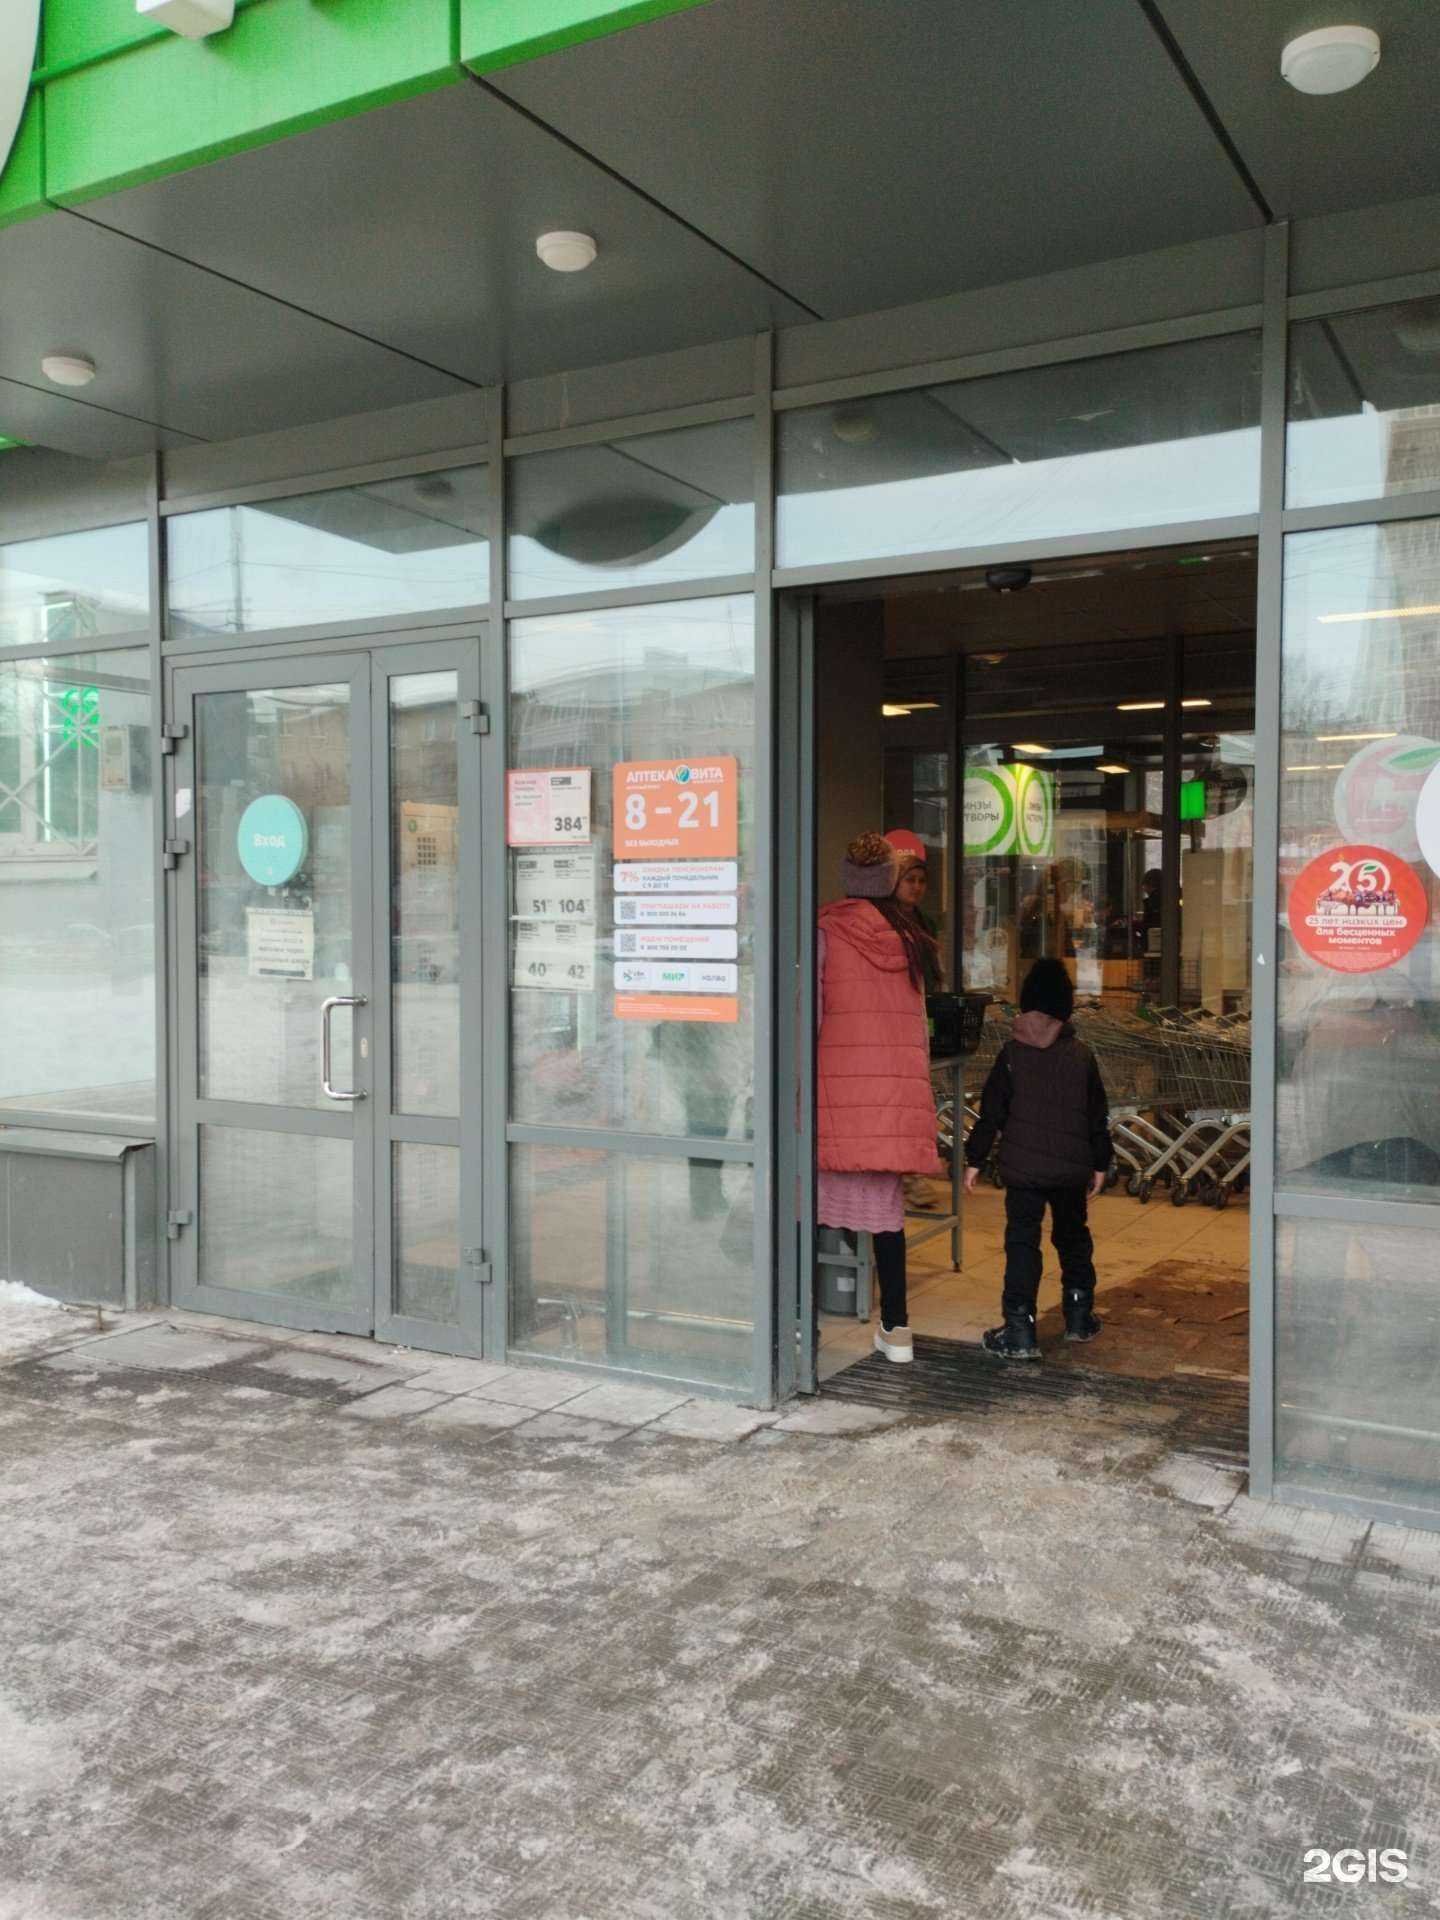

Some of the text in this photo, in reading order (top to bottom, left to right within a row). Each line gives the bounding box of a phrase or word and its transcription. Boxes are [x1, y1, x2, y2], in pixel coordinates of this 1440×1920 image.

[626, 767, 724, 783] АПТЕКА ВИТА
[625, 793, 647, 831] 8
[677, 790, 719, 829] 21
[554, 816, 583, 832] 384
[253, 834, 286, 848] Вход
[532, 899, 547, 913] 51
[559, 899, 586, 914] 104
[1315, 927, 1397, 938] для бесценных
[528, 962, 547, 977] 40
[567, 964, 585, 980] 42
